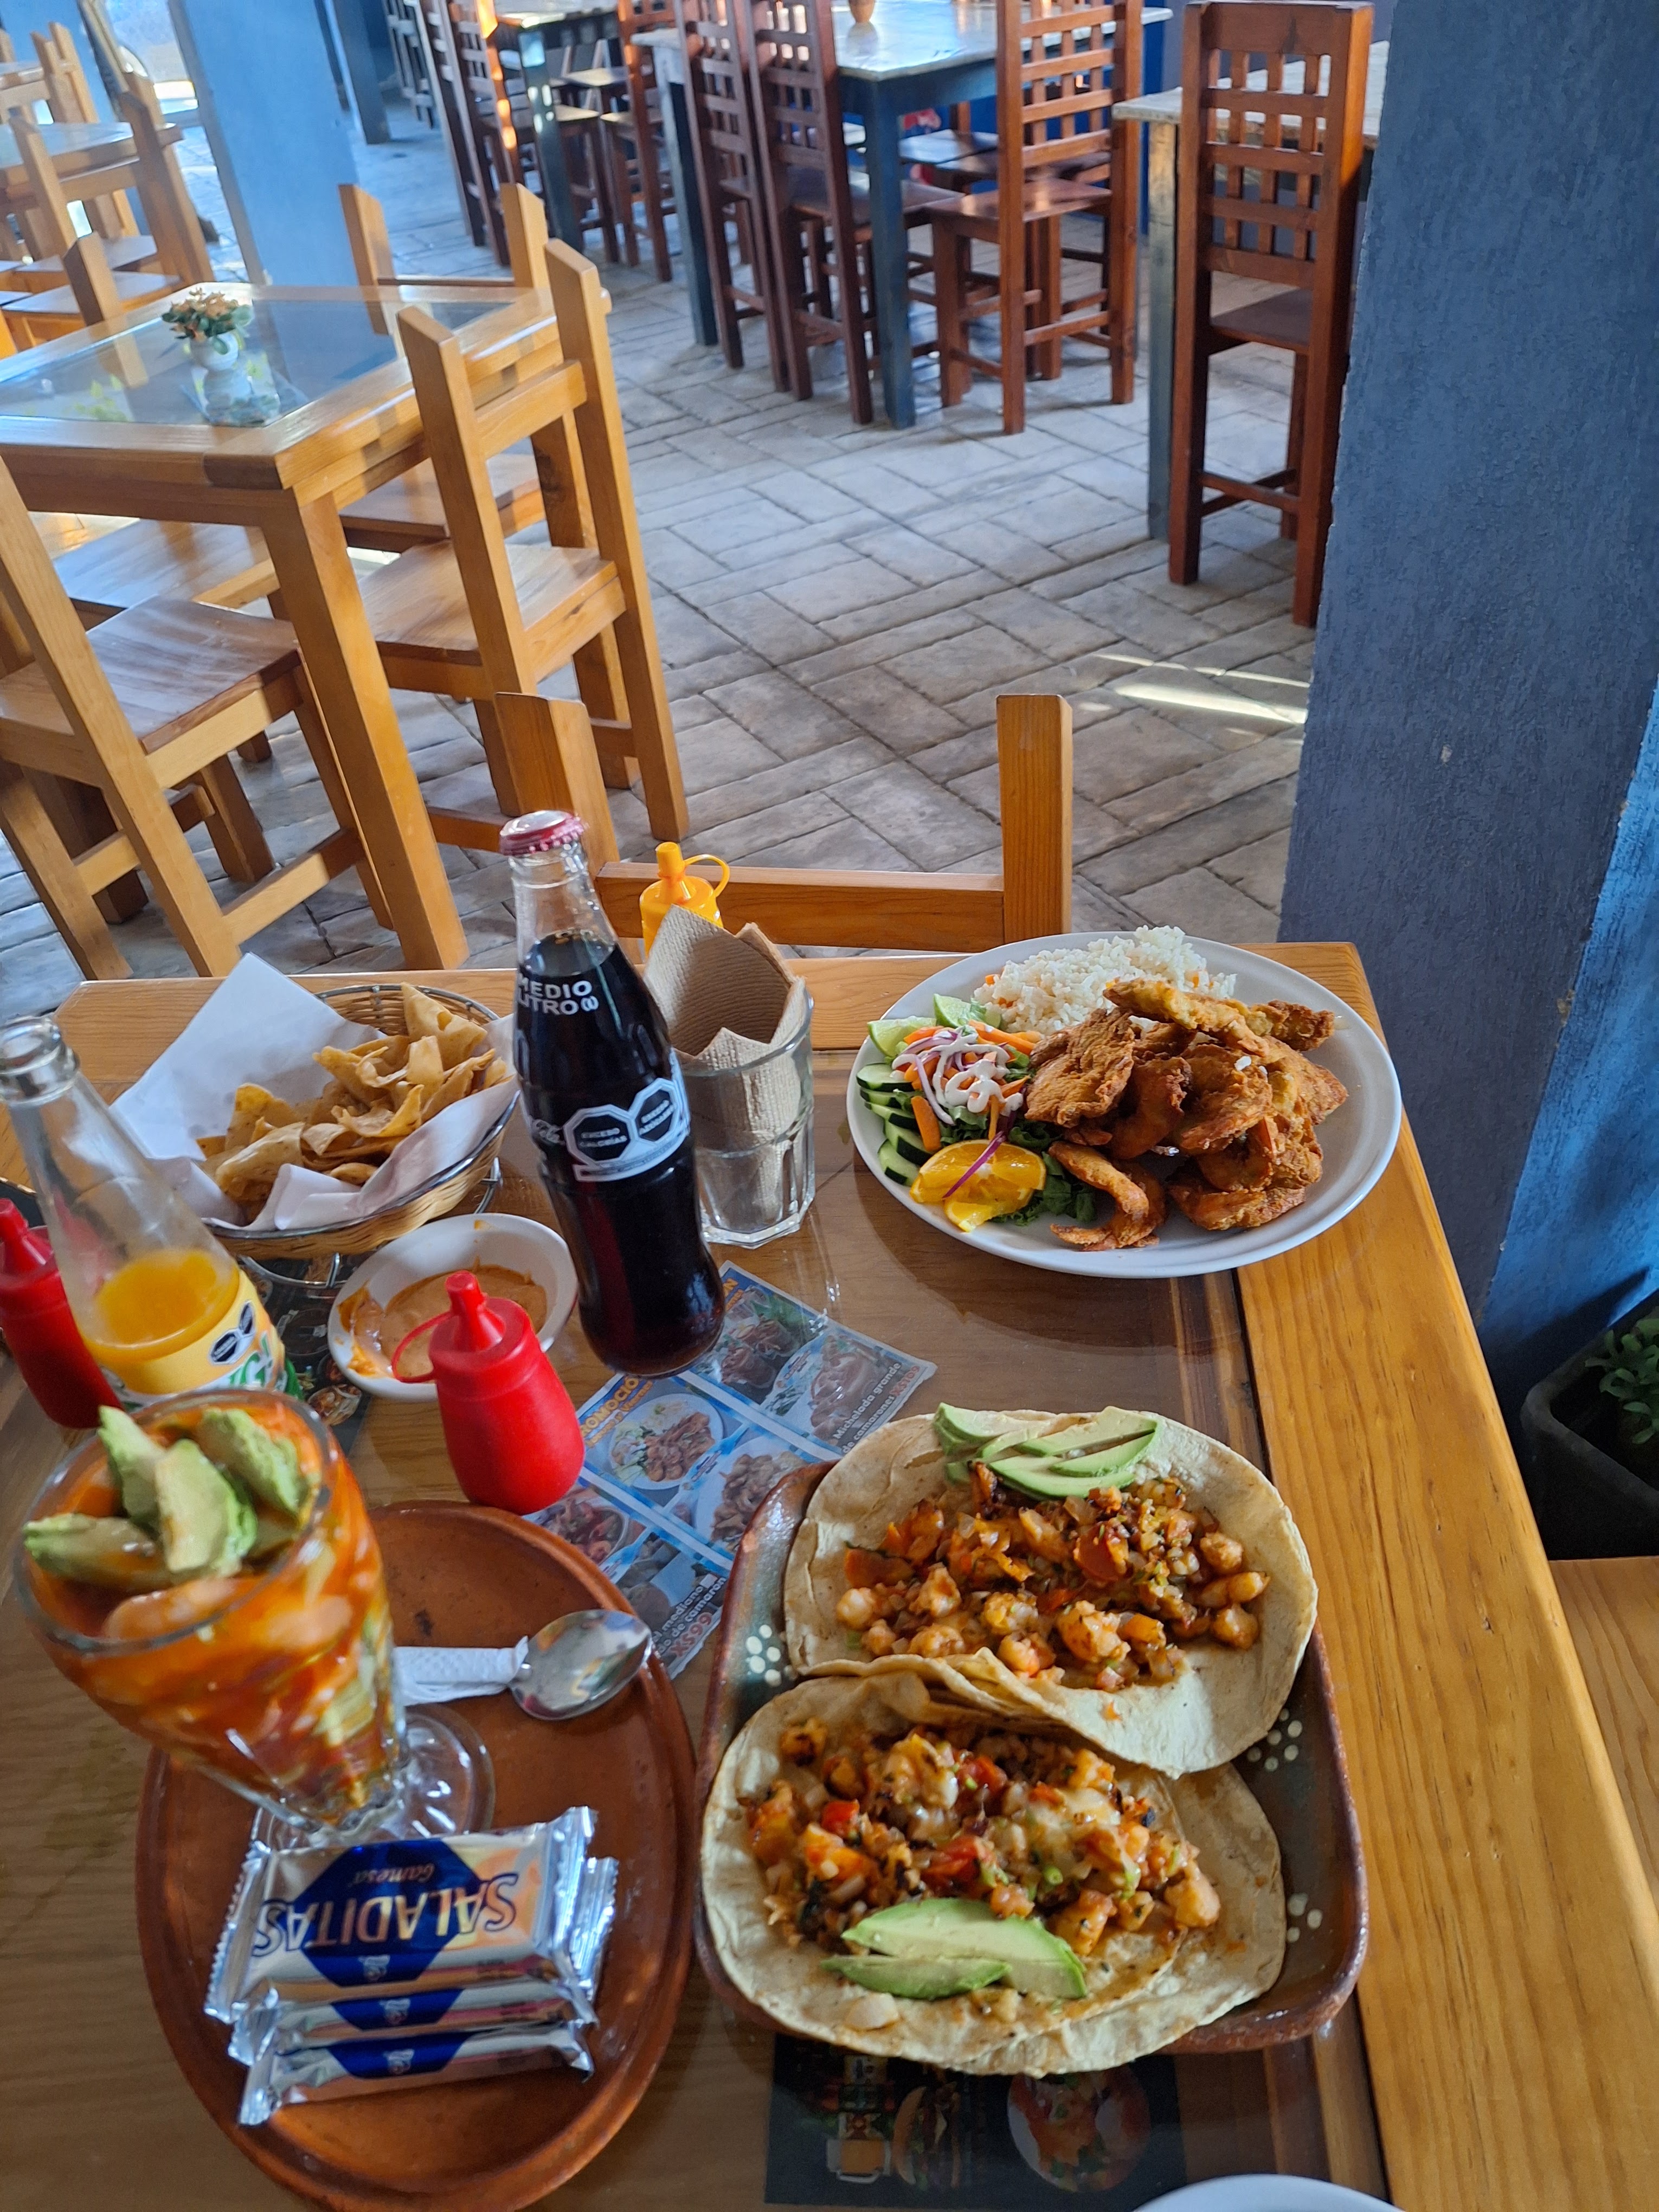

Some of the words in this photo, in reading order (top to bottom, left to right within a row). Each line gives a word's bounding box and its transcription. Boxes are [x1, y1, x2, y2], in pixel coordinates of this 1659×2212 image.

[581, 1376, 639, 1437] ROMOCIÓ
[833, 1394, 876, 1439] Michelada
[873, 1362, 902, 1394] grande
[853, 1395, 895, 1441] camarones
[661, 1586, 704, 1631] mediano
[671, 1623, 686, 1637] de
[252, 1873, 518, 1957] SALADITAS
